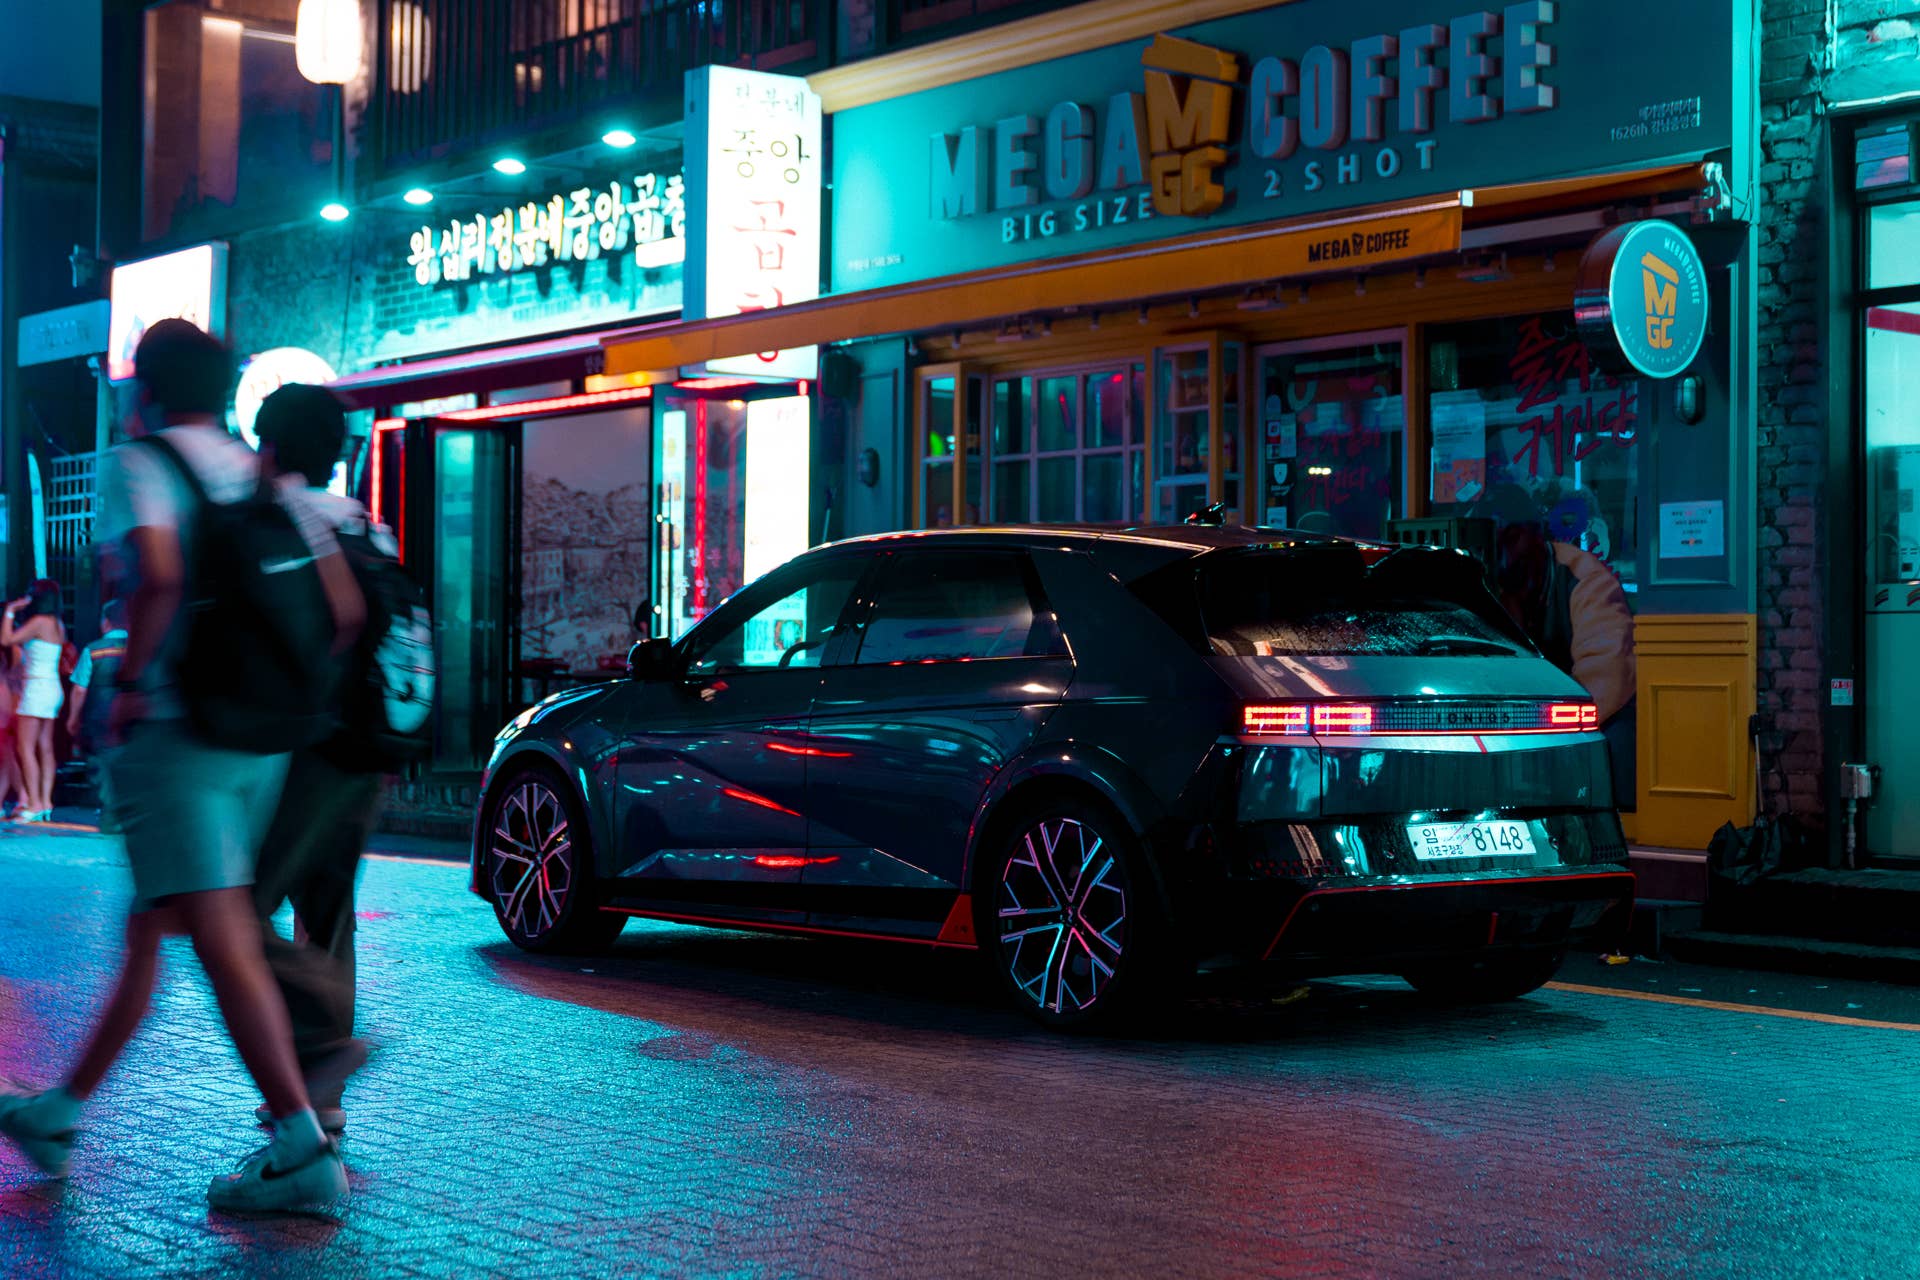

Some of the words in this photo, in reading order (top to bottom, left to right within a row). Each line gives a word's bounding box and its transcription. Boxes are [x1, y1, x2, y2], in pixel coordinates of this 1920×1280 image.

[929, 91, 1150, 222] MEGA
[1250, 0, 1554, 159] COFFEE
[1263, 169, 1281, 198] 2
[1304, 139, 1438, 191] SHOT
[1002, 209, 1056, 243] BIG
[1074, 191, 1153, 233] SIZE
[1308, 236, 1351, 263] MEGA
[1366, 228, 1411, 254] COFFEE
[1436, 711, 1499, 724] IONIQ
[1422, 827, 1439, 844] 임
[1471, 825, 1523, 851] 8148
